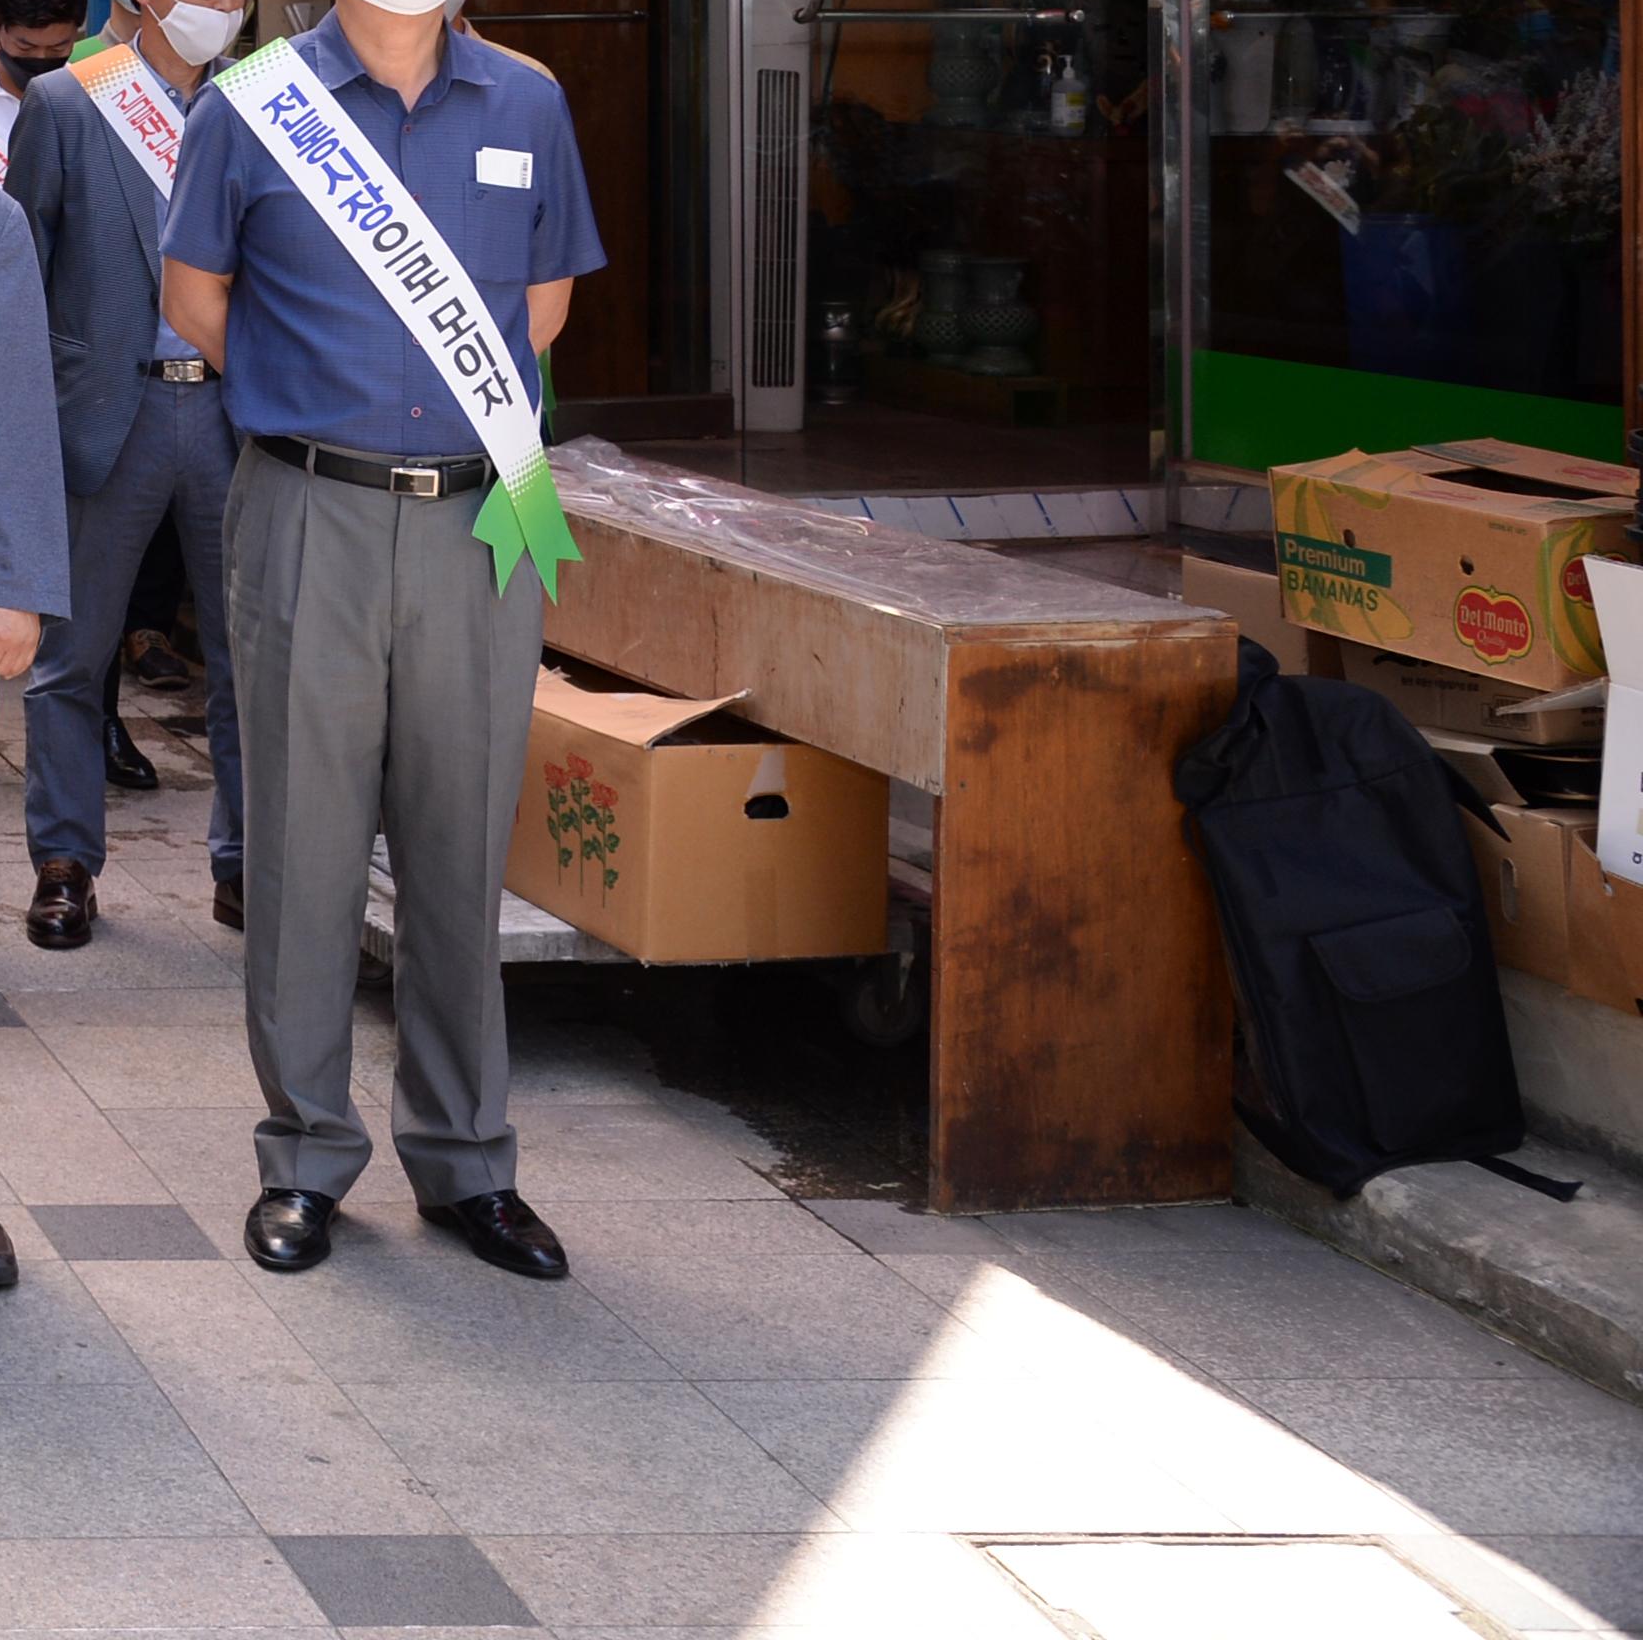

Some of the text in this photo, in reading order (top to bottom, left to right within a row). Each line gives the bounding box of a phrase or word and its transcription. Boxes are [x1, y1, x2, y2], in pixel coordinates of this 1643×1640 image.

[260, 81, 514, 419] 전통시장으로 모이자
[1284, 538, 1366, 576] Premium
[1286, 570, 1379, 612] BANANAS
[1460, 604, 1527, 638] Del Monte
